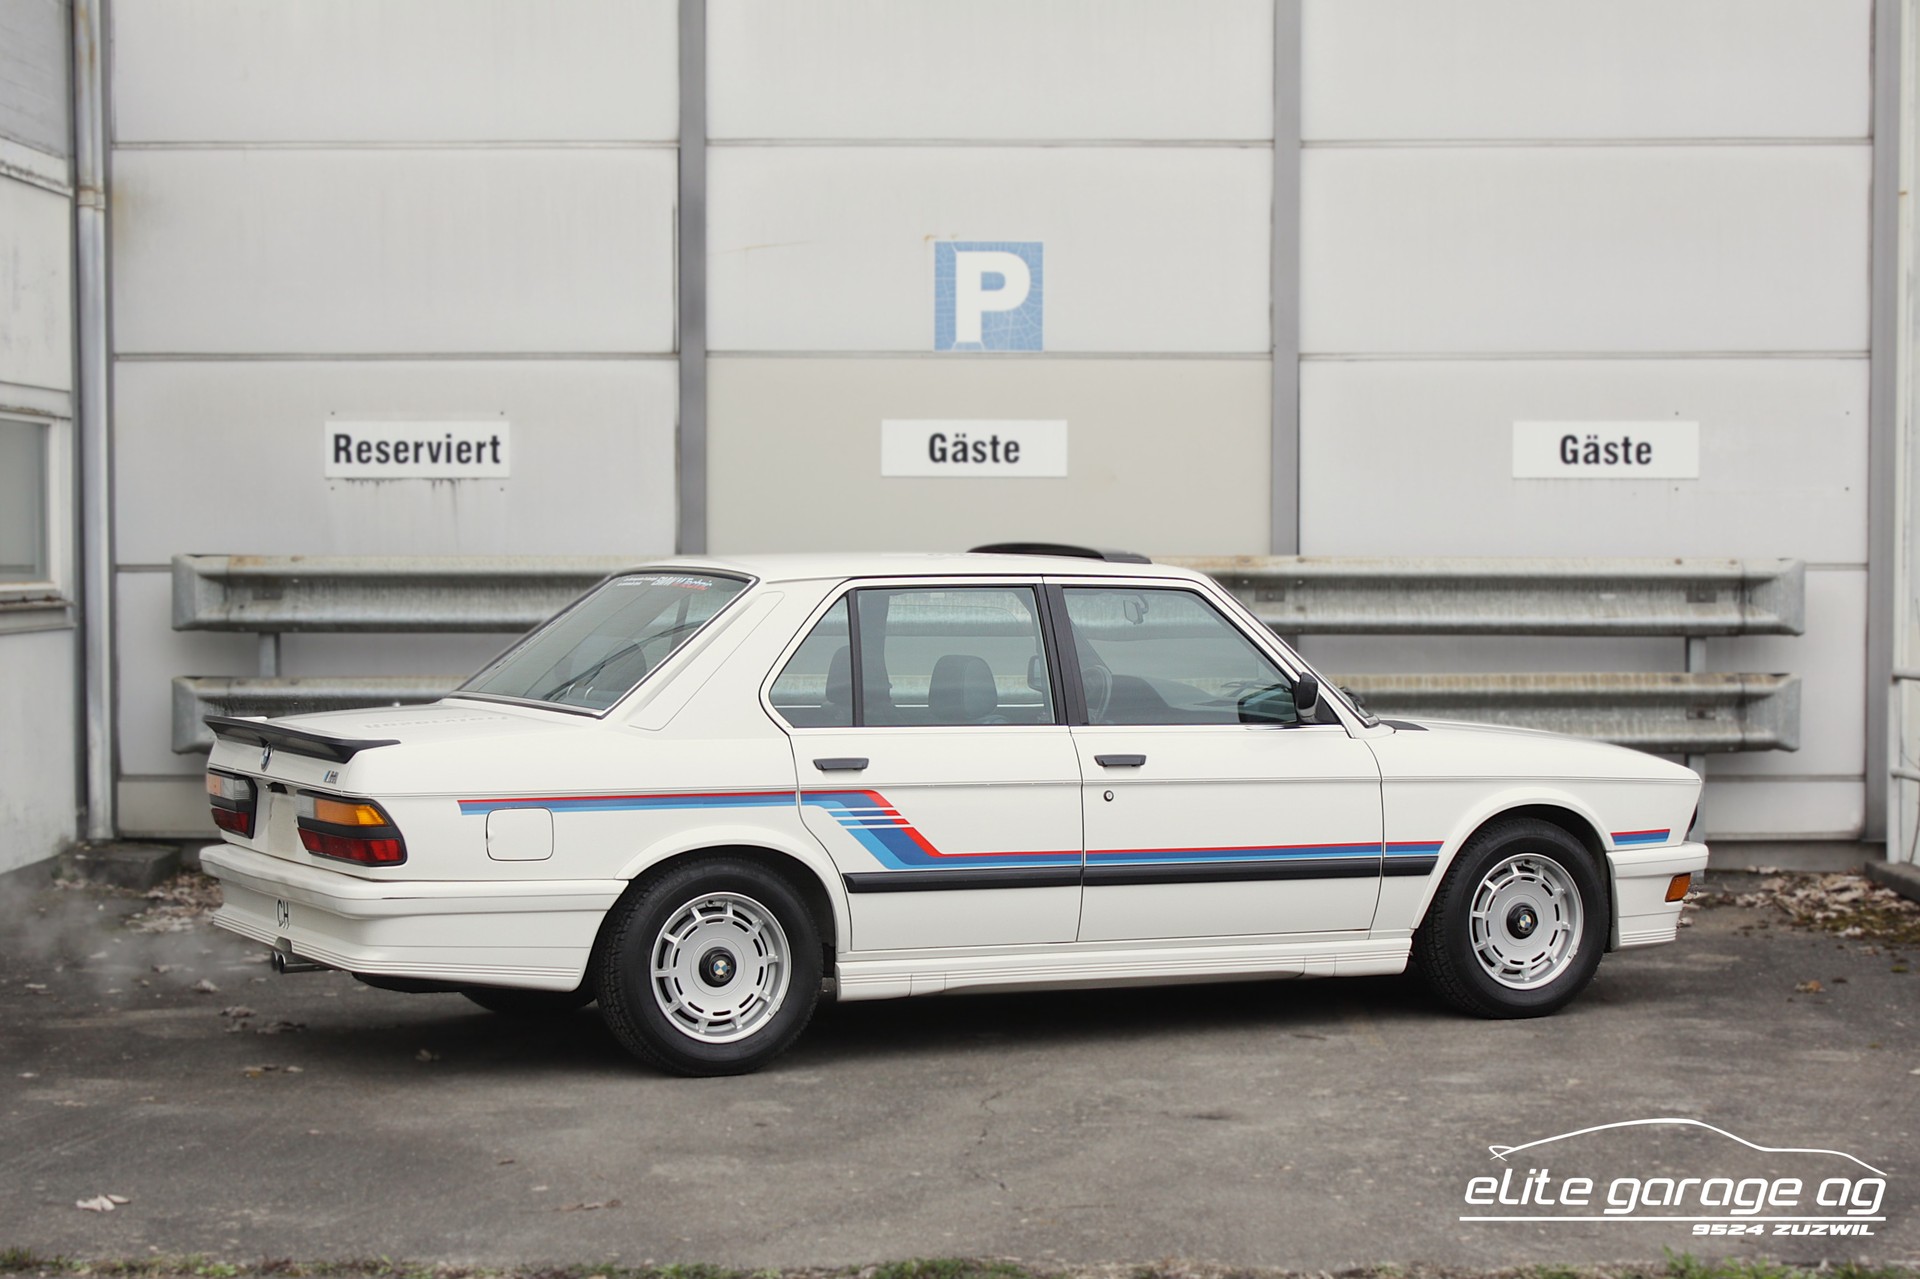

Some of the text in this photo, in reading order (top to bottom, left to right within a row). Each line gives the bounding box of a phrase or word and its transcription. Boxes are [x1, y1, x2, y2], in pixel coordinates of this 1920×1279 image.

[955, 251, 1031, 342] P
[333, 434, 501, 464] Reserviert
[928, 434, 1020, 464] Gäste
[1560, 434, 1652, 465] Gäste
[277, 899, 290, 930] CH
